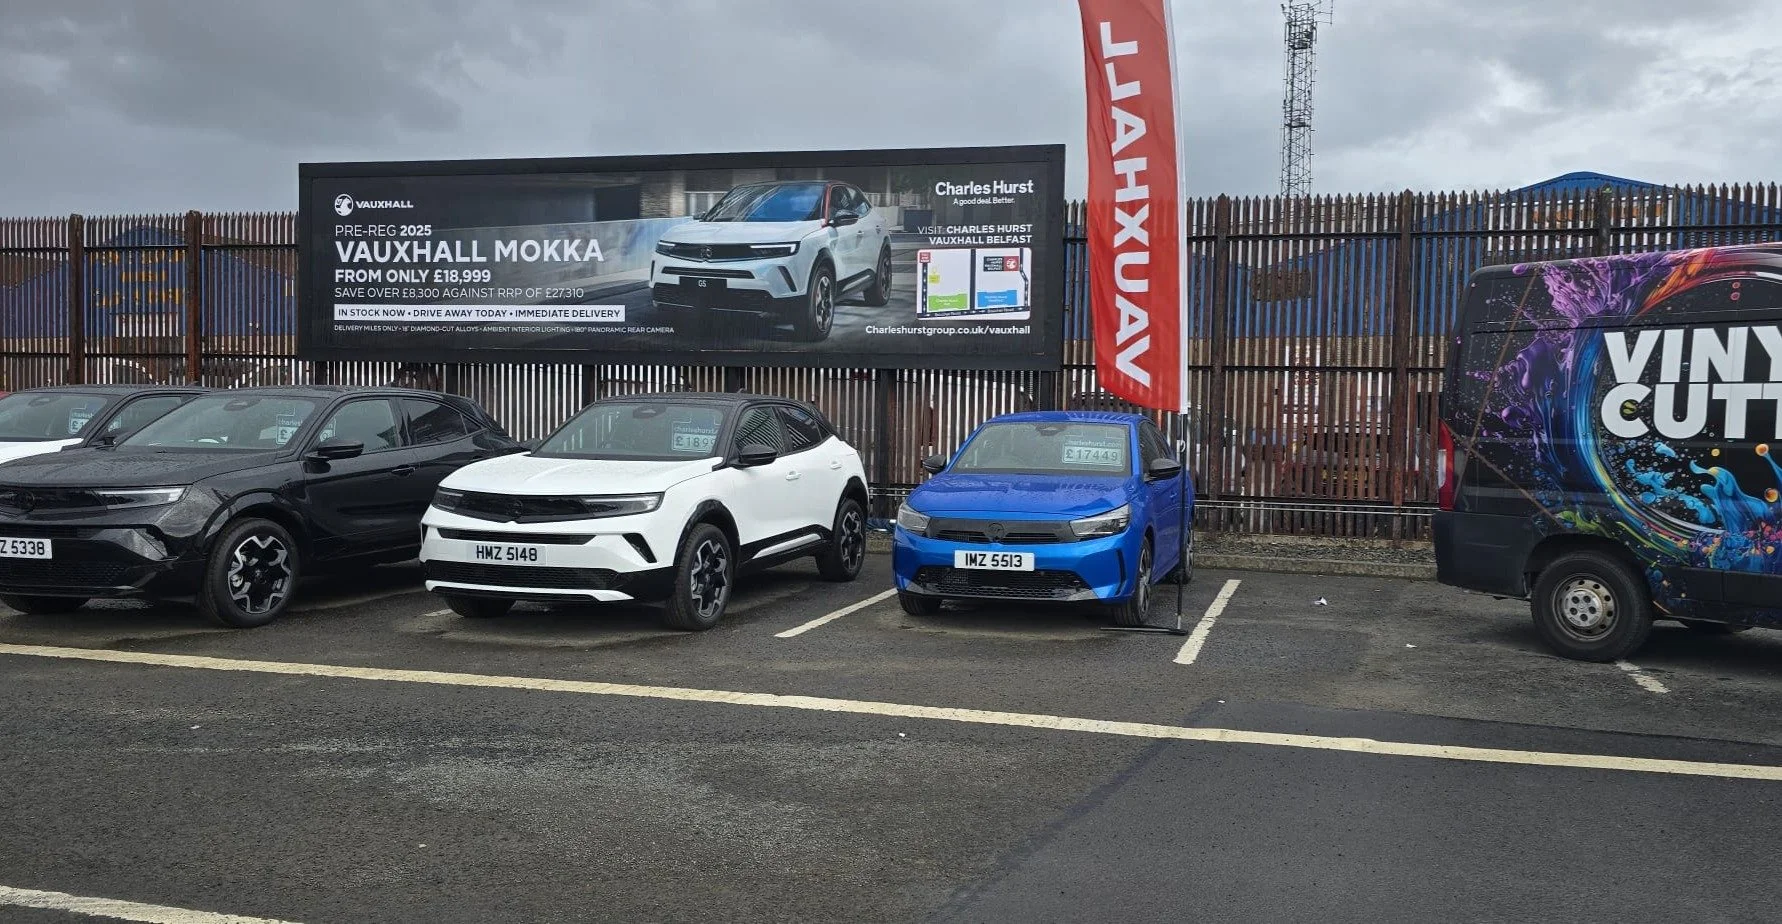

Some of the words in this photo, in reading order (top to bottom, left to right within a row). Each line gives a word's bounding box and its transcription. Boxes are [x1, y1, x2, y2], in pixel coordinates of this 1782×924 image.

[935, 181, 991, 196] Charles
[993, 180, 1034, 195] Hurst
[355, 200, 414, 209] VAUXHALL
[960, 198, 976, 207] good
[335, 224, 397, 237] PRE-REG
[399, 224, 432, 237] 2025
[946, 225, 995, 234] CHARLES
[997, 224, 1033, 233] HURST
[929, 236, 984, 245] VAUXHALL
[986, 235, 1033, 244] BELFAST
[335, 240, 487, 263] VAUXHALL
[494, 239, 605, 262] MOKKA
[335, 269, 382, 283] FROM
[386, 269, 429, 283] ONLY
[433, 269, 491, 285] £18,999
[334, 287, 365, 298] SAVE
[367, 287, 400, 298] OVER
[402, 288, 440, 299] £8,300
[442, 287, 494, 298] AGAINST
[498, 287, 522, 298] RRP
[525, 287, 542, 298] OF
[545, 287, 584, 299] £27,310
[338, 308, 348, 317] IN
[350, 308, 380, 317] STOCK
[382, 308, 406, 317] NOW
[413, 309, 442, 318] DRIVE
[444, 309, 473, 318] AWAY
[476, 309, 507, 318] TODAY
[515, 309, 570, 318] IMMEDIATE
[572, 309, 620, 318] DELIVERY
[334, 324, 362, 332] DELIVERY
[865, 325, 1031, 336] Charleshurstgroup.co.uk/vauxhall
[1065, 448, 1118, 462] £17449
[11, 540, 45, 556] 5338
[476, 545, 502, 561] HMZ
[506, 546, 538, 562] 5148
[991, 554, 1022, 568] 5513
